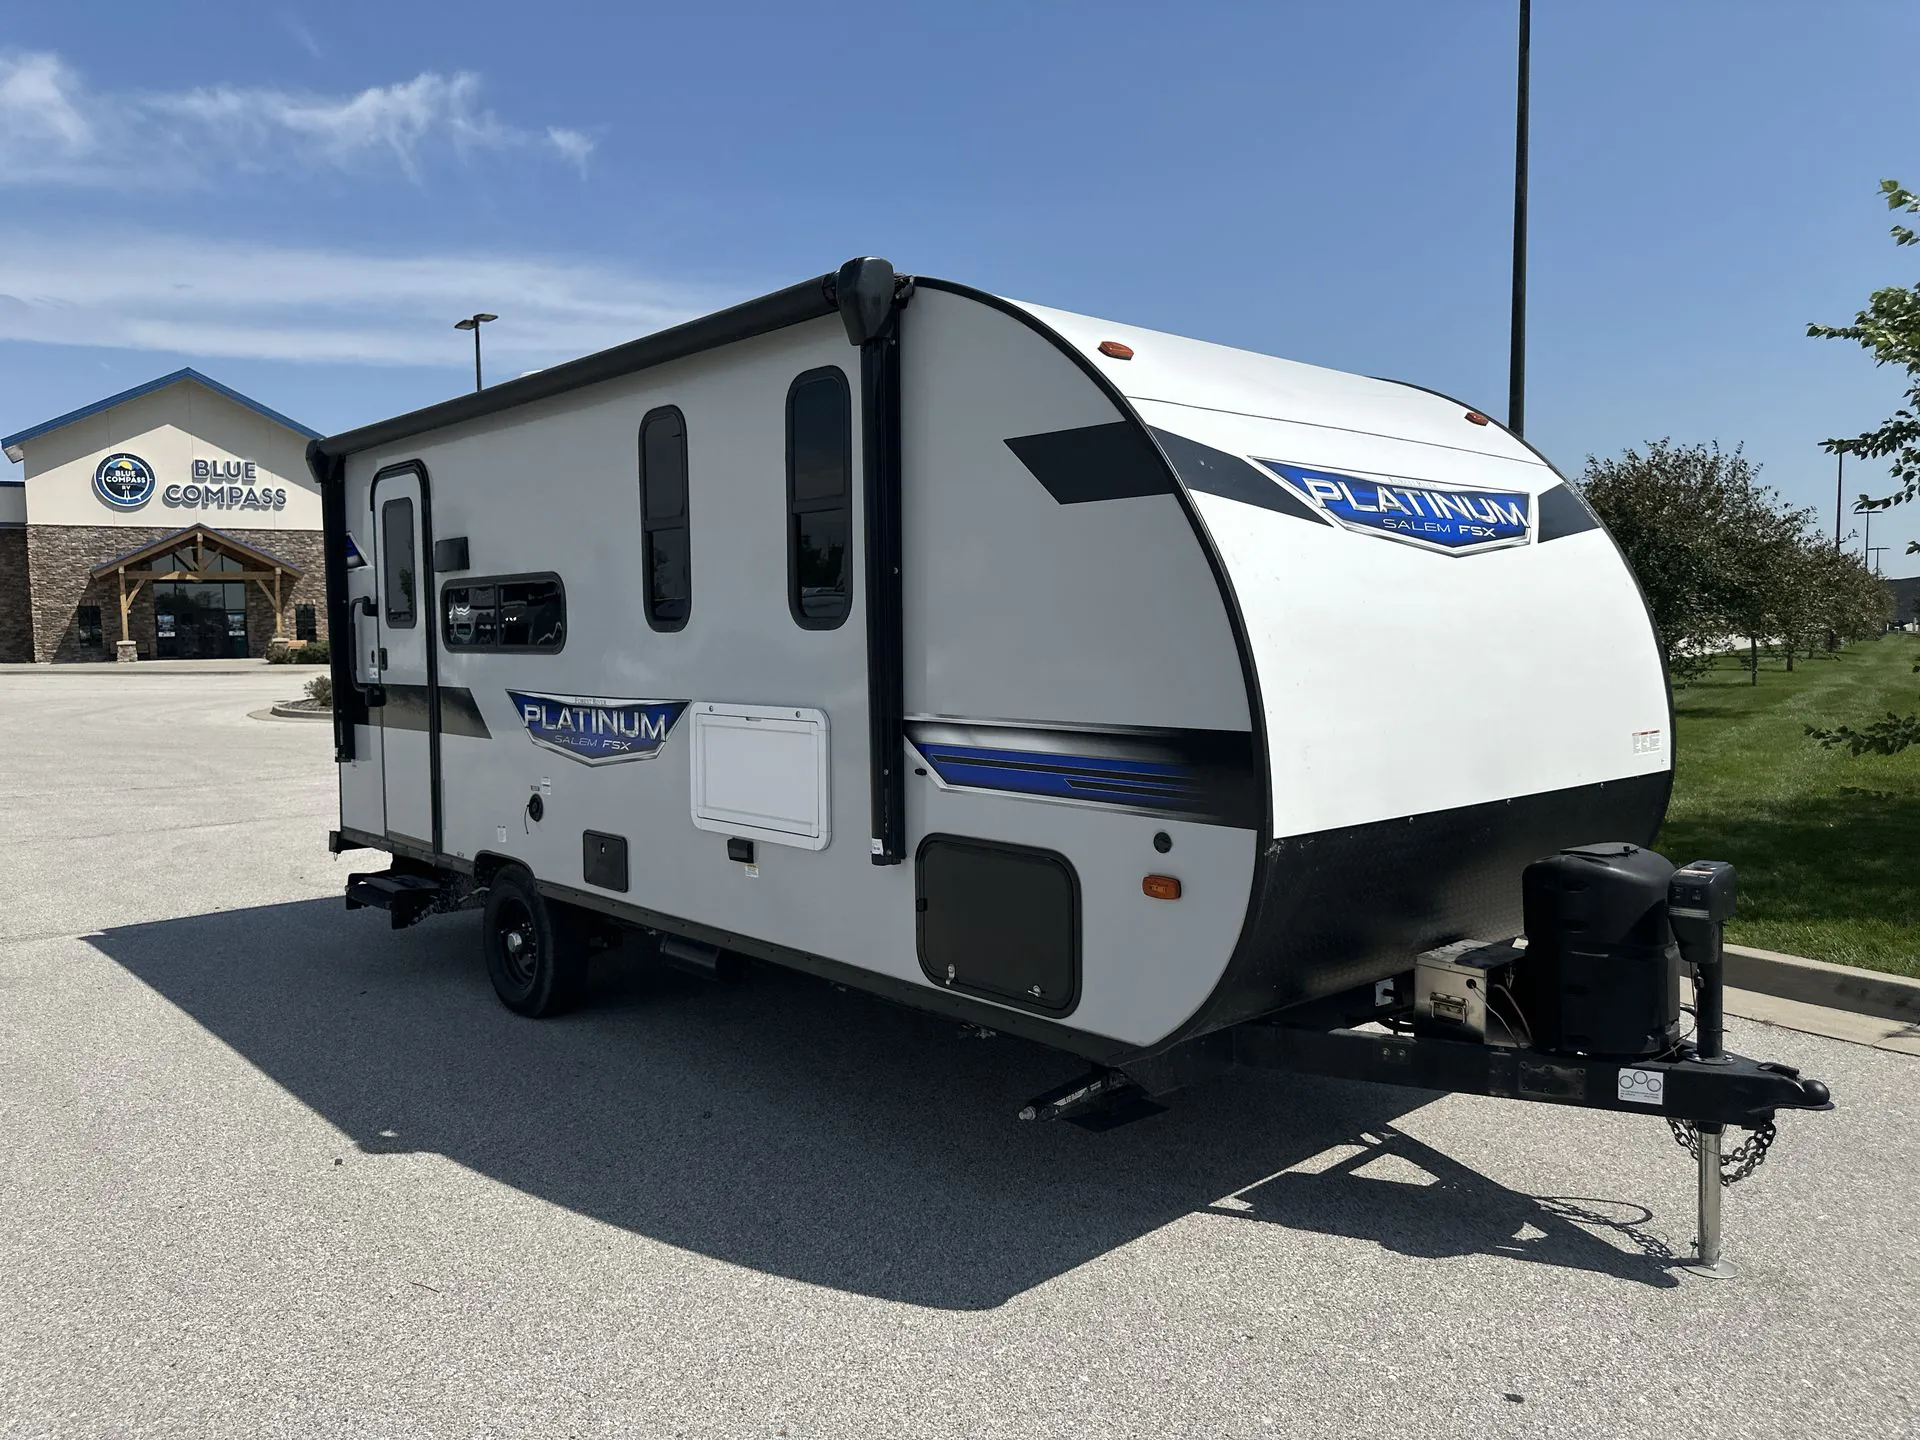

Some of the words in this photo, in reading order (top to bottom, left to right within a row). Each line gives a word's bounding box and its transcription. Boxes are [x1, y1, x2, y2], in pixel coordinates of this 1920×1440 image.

[193, 459, 256, 479] BLUE
[106, 476, 146, 484] COMPASS
[165, 484, 287, 505] COMPASS
[1302, 478, 1531, 528] PLATINUM
[1383, 518, 1451, 533] SALEM
[1459, 525, 1496, 537] FSX
[524, 704, 665, 741] PLATINUM
[555, 735, 597, 747] SALEM
[602, 740, 631, 750] FSX
